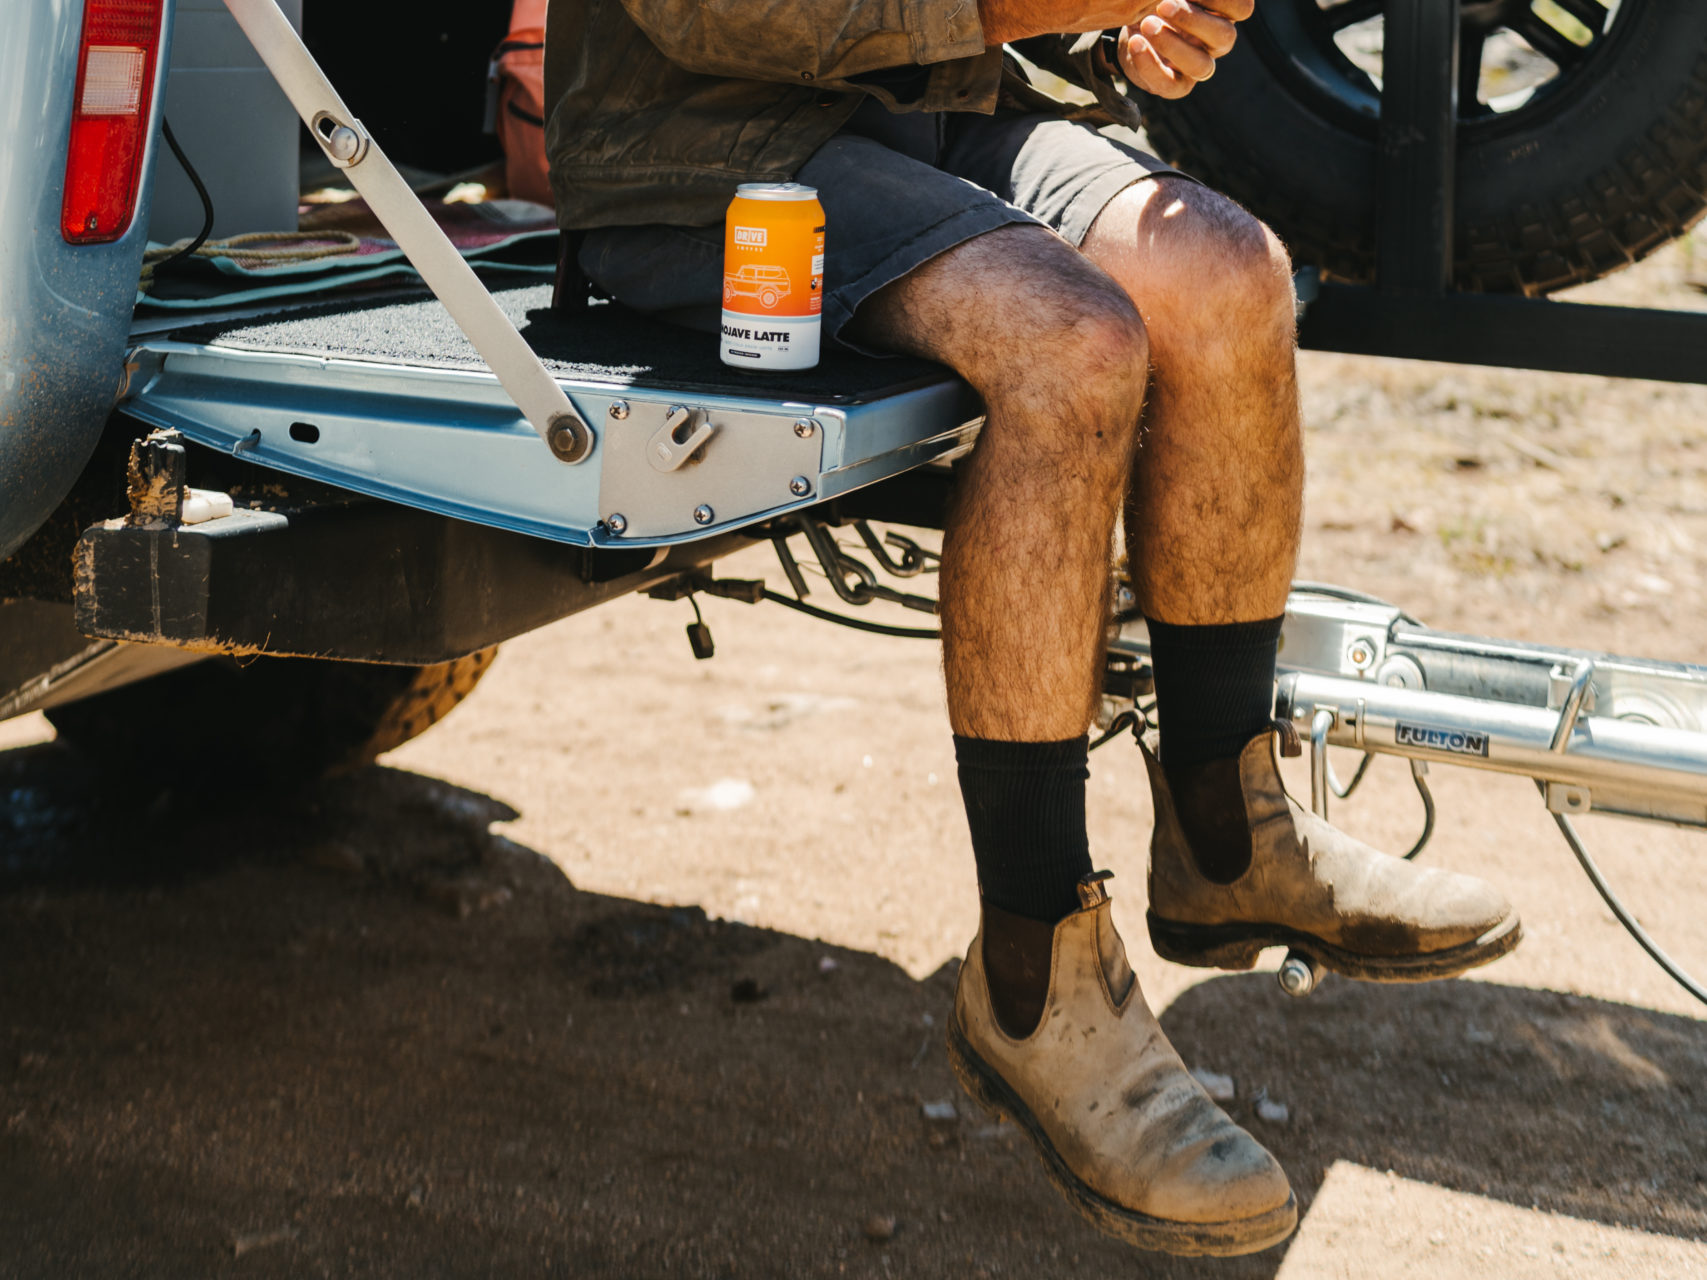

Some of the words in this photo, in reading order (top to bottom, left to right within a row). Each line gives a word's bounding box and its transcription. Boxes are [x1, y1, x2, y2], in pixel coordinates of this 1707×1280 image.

[736, 230, 763, 242] DRIVE
[754, 331, 790, 342] LATTE
[1399, 725, 1483, 751] FULTON
